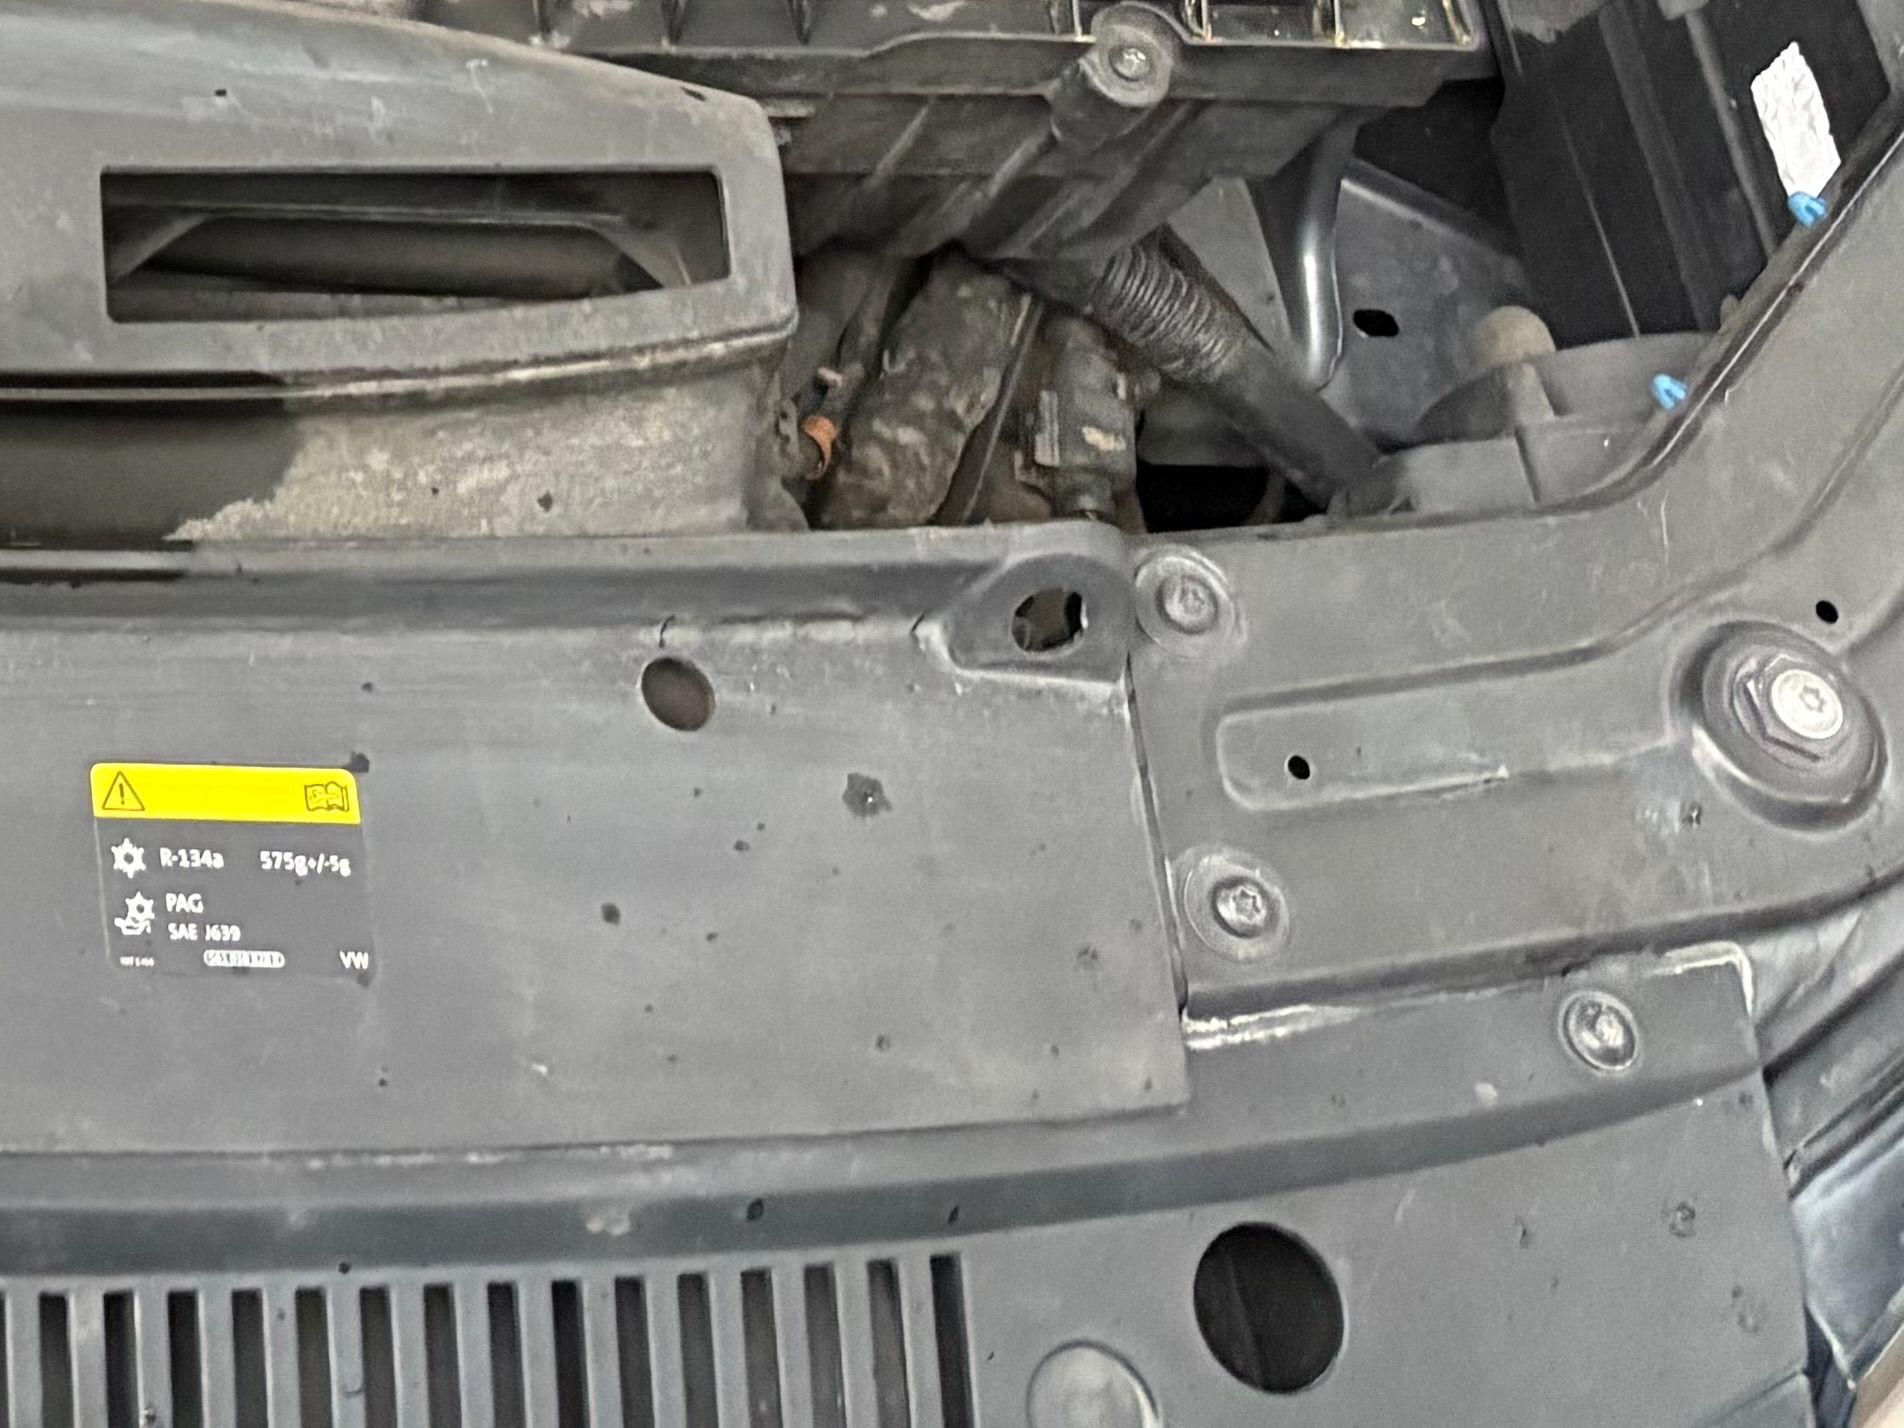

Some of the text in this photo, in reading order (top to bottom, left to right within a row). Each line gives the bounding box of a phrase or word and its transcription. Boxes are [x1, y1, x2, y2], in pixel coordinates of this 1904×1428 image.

[159, 847, 351, 877] R-134a 575g+/-5g
[165, 893, 204, 914] PAG
[168, 923, 198, 941] SAE
[339, 951, 369, 970] VW
